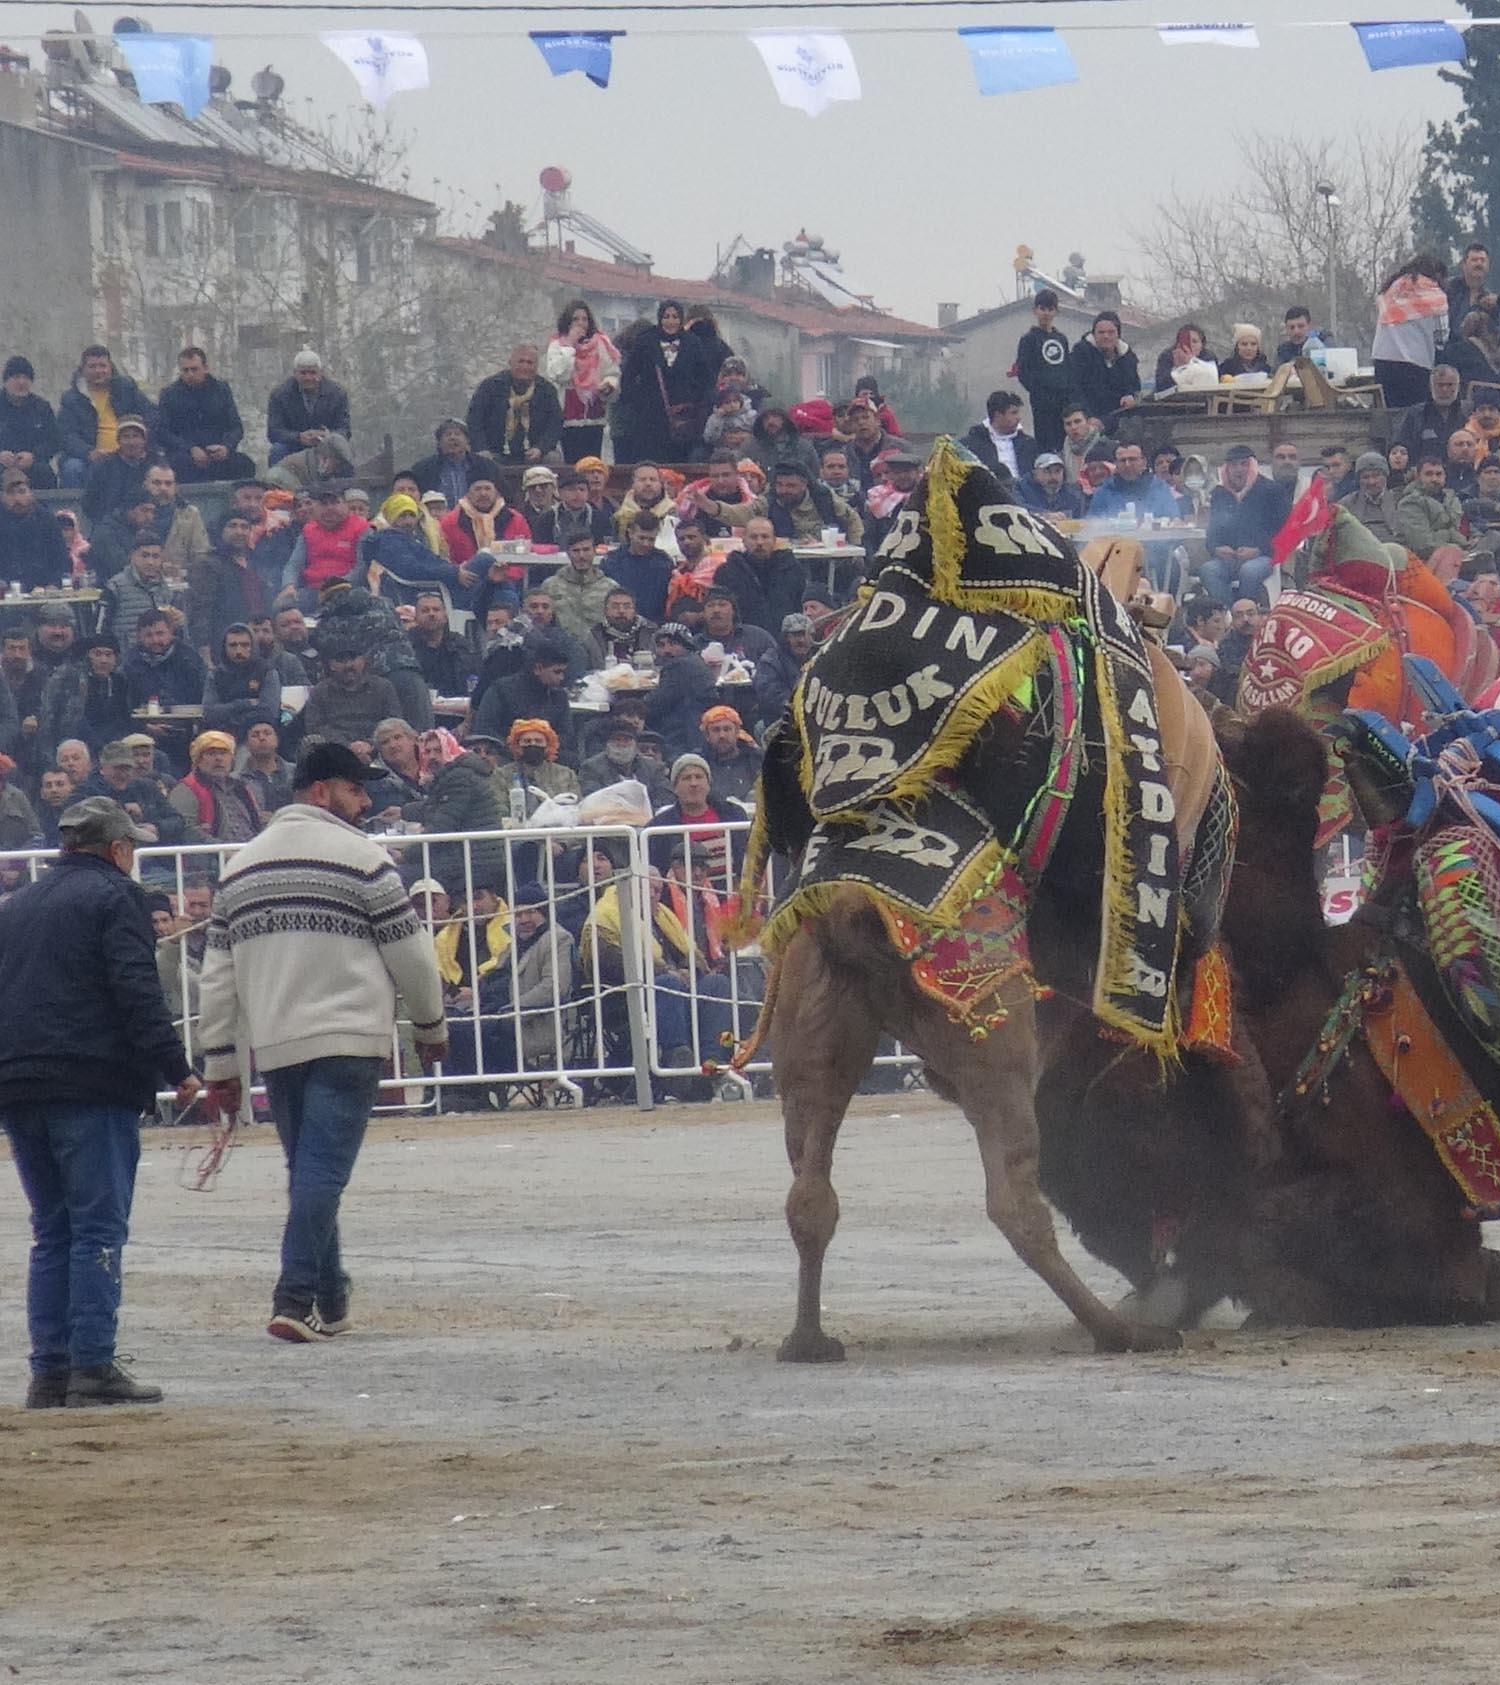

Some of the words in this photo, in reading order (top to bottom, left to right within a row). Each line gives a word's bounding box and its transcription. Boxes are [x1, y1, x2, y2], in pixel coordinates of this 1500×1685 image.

[838, 591, 998, 662] DIN
[1284, 627, 1315, 660] 10
[1128, 688, 1176, 928] AYDIN
